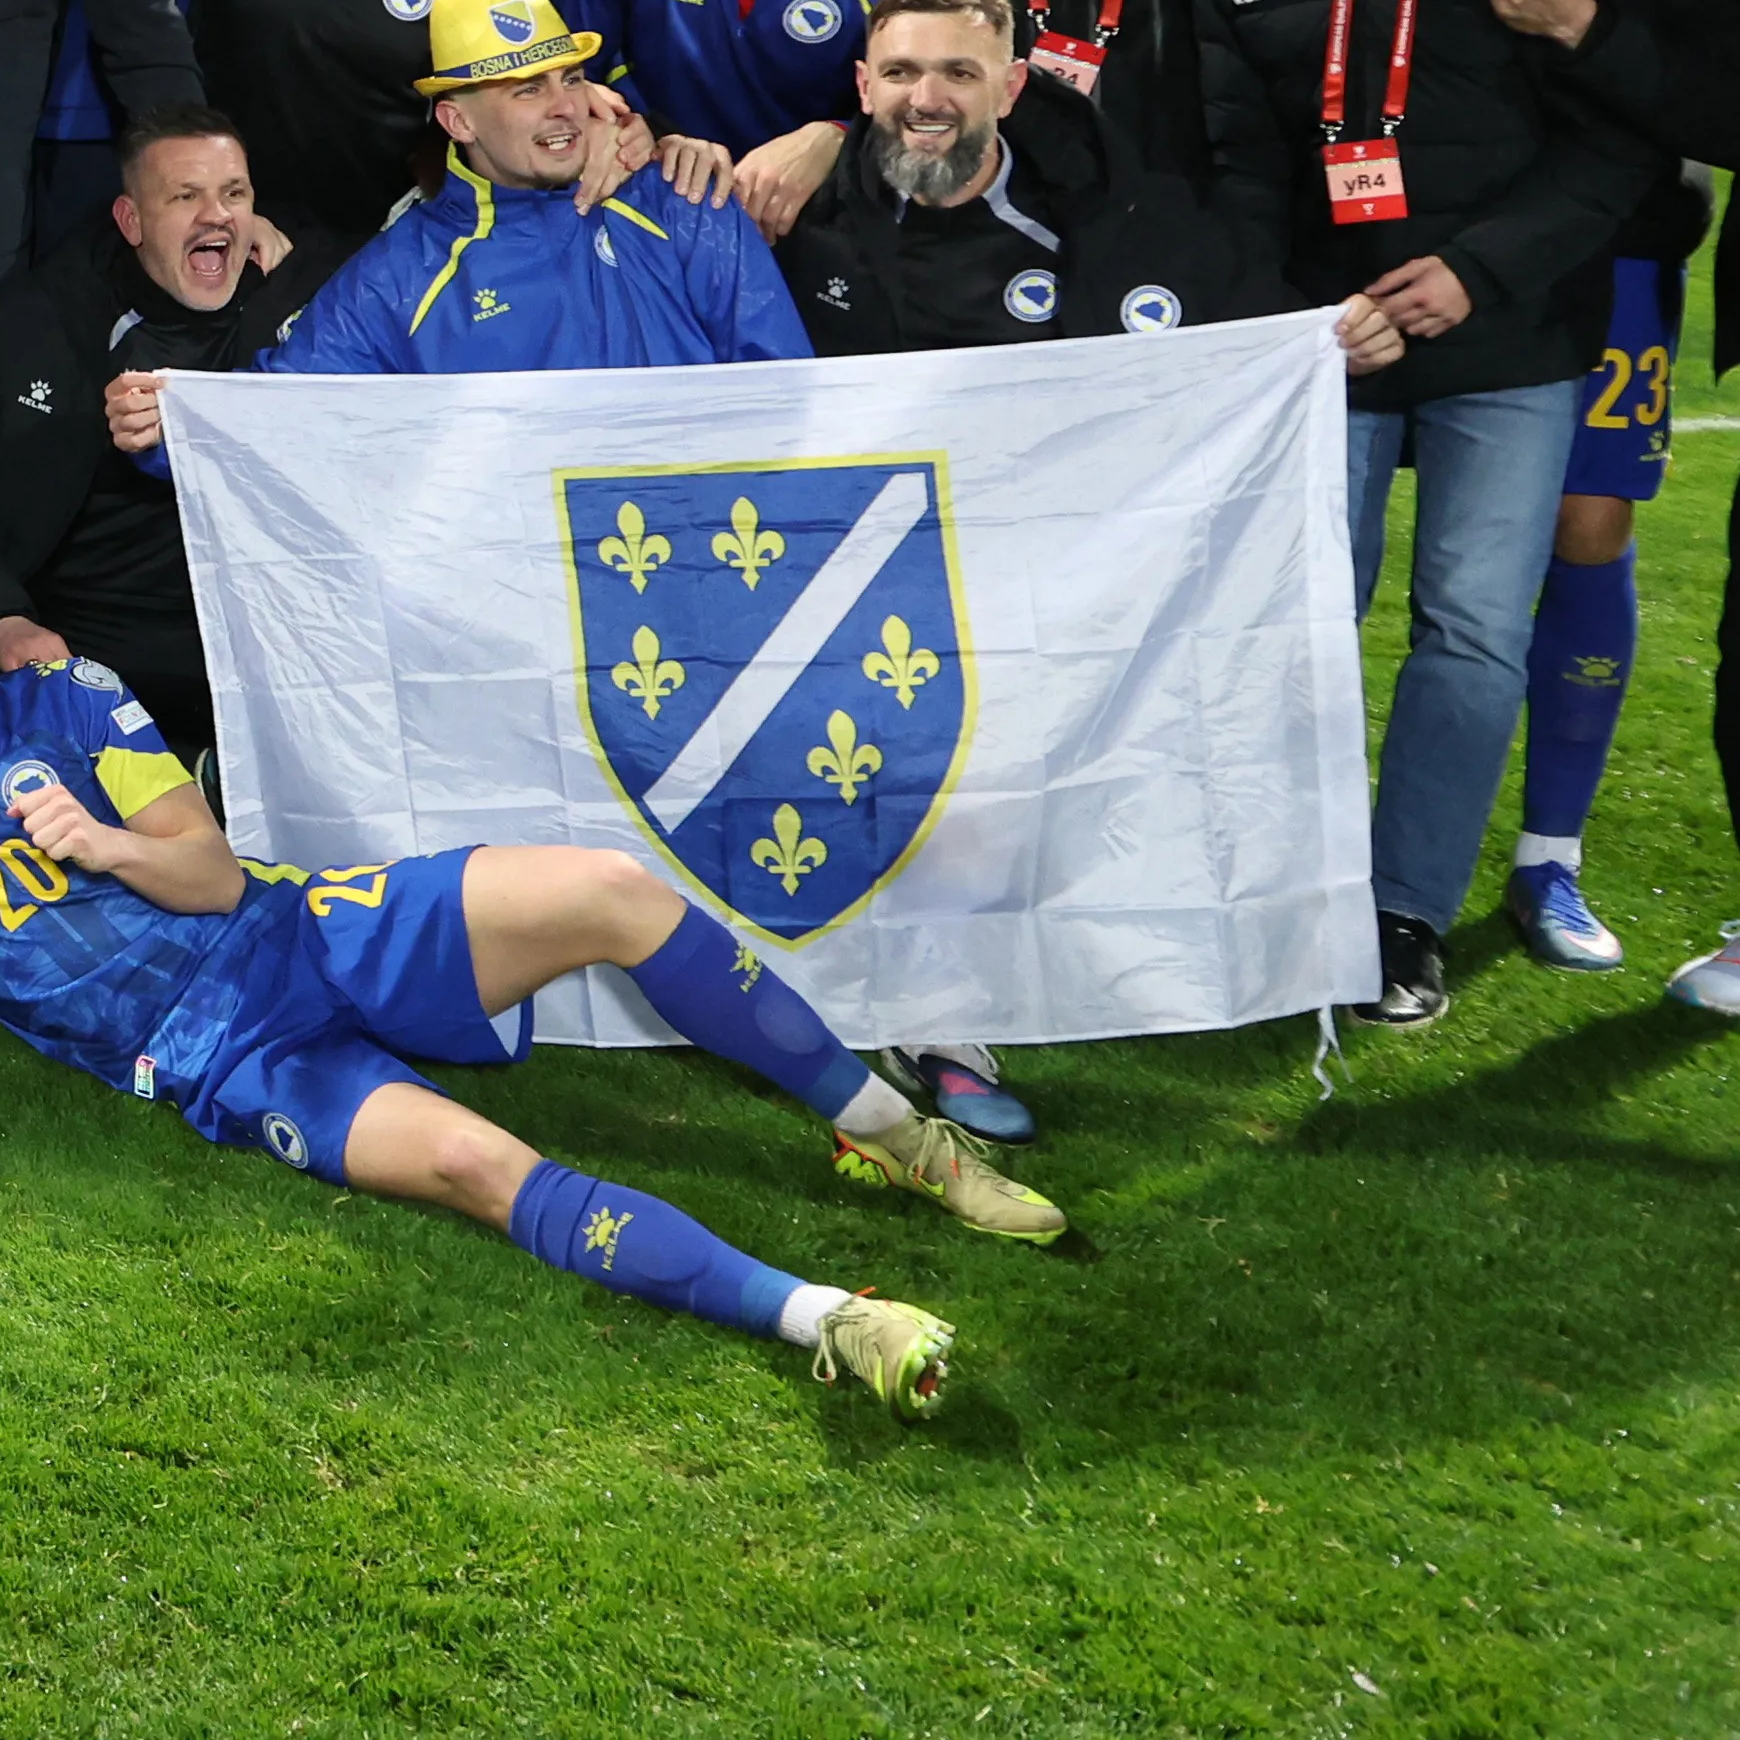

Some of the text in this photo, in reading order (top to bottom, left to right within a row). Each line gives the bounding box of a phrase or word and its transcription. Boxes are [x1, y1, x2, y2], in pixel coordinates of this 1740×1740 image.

[469, 59, 511, 79] BOSNA
[521, 35, 578, 64] HERCEGO
[1343, 172, 1387, 195] yR4
[472, 302, 512, 322] KELME
[816, 291, 852, 311] KELME
[1586, 346, 1669, 429] 23
[601, 1211, 635, 1272] KELME
